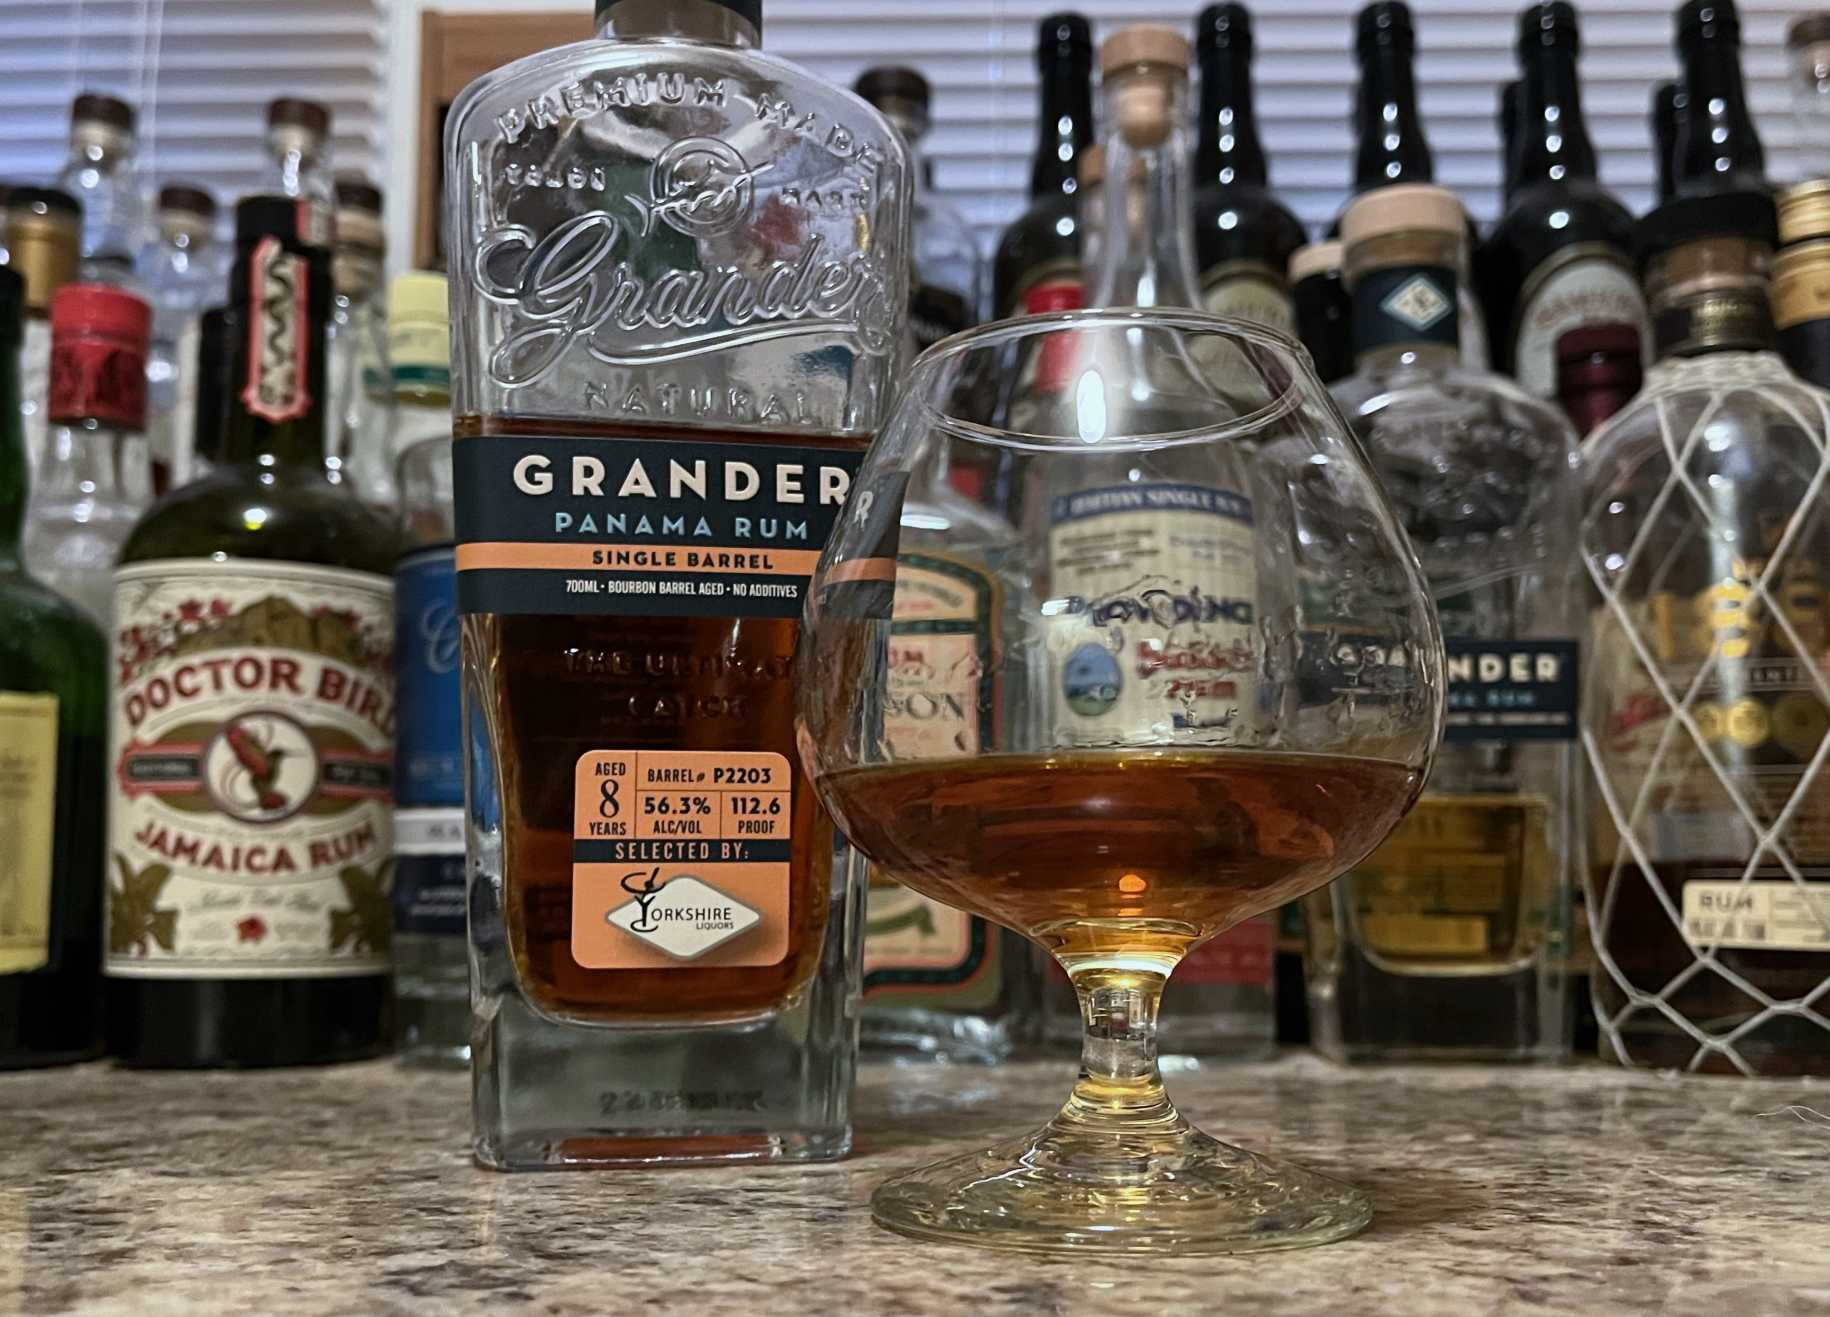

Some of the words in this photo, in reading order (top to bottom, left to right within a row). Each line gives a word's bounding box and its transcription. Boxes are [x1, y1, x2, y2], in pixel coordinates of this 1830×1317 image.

[512, 454, 850, 505] GRANDER
[554, 512, 713, 537] PANAMA
[734, 517, 808, 540] RUM
[592, 550, 678, 567] SINGLE
[687, 552, 774, 570] BARREL
[566, 579, 599, 593] 700ML
[608, 580, 656, 595] BOURBON
[659, 581, 696, 596] BARREL
[699, 583, 724, 597] AGED
[733, 584, 747, 597] NO
[750, 584, 798, 598] ADDITIVES
[1447, 653, 1559, 683] NDER
[124, 656, 303, 728] DOCTOR
[595, 762, 626, 776] AGED
[713, 767, 772, 784] P2203
[599, 779, 620, 818] 8
[644, 796, 711, 815] 56.3%
[731, 797, 781, 815] 112.6
[589, 821, 627, 836] YEARS
[653, 820, 702, 834] ALC/VOL
[738, 820, 775, 834] PROOF
[134, 819, 297, 874] JAMAICA
[309, 818, 377, 870] RUM
[615, 842, 710, 860] SELECTED
[721, 843, 749, 860] BY:
[629, 892, 732, 932] YORKSHIRE
[696, 922, 734, 930] LIQUORS
